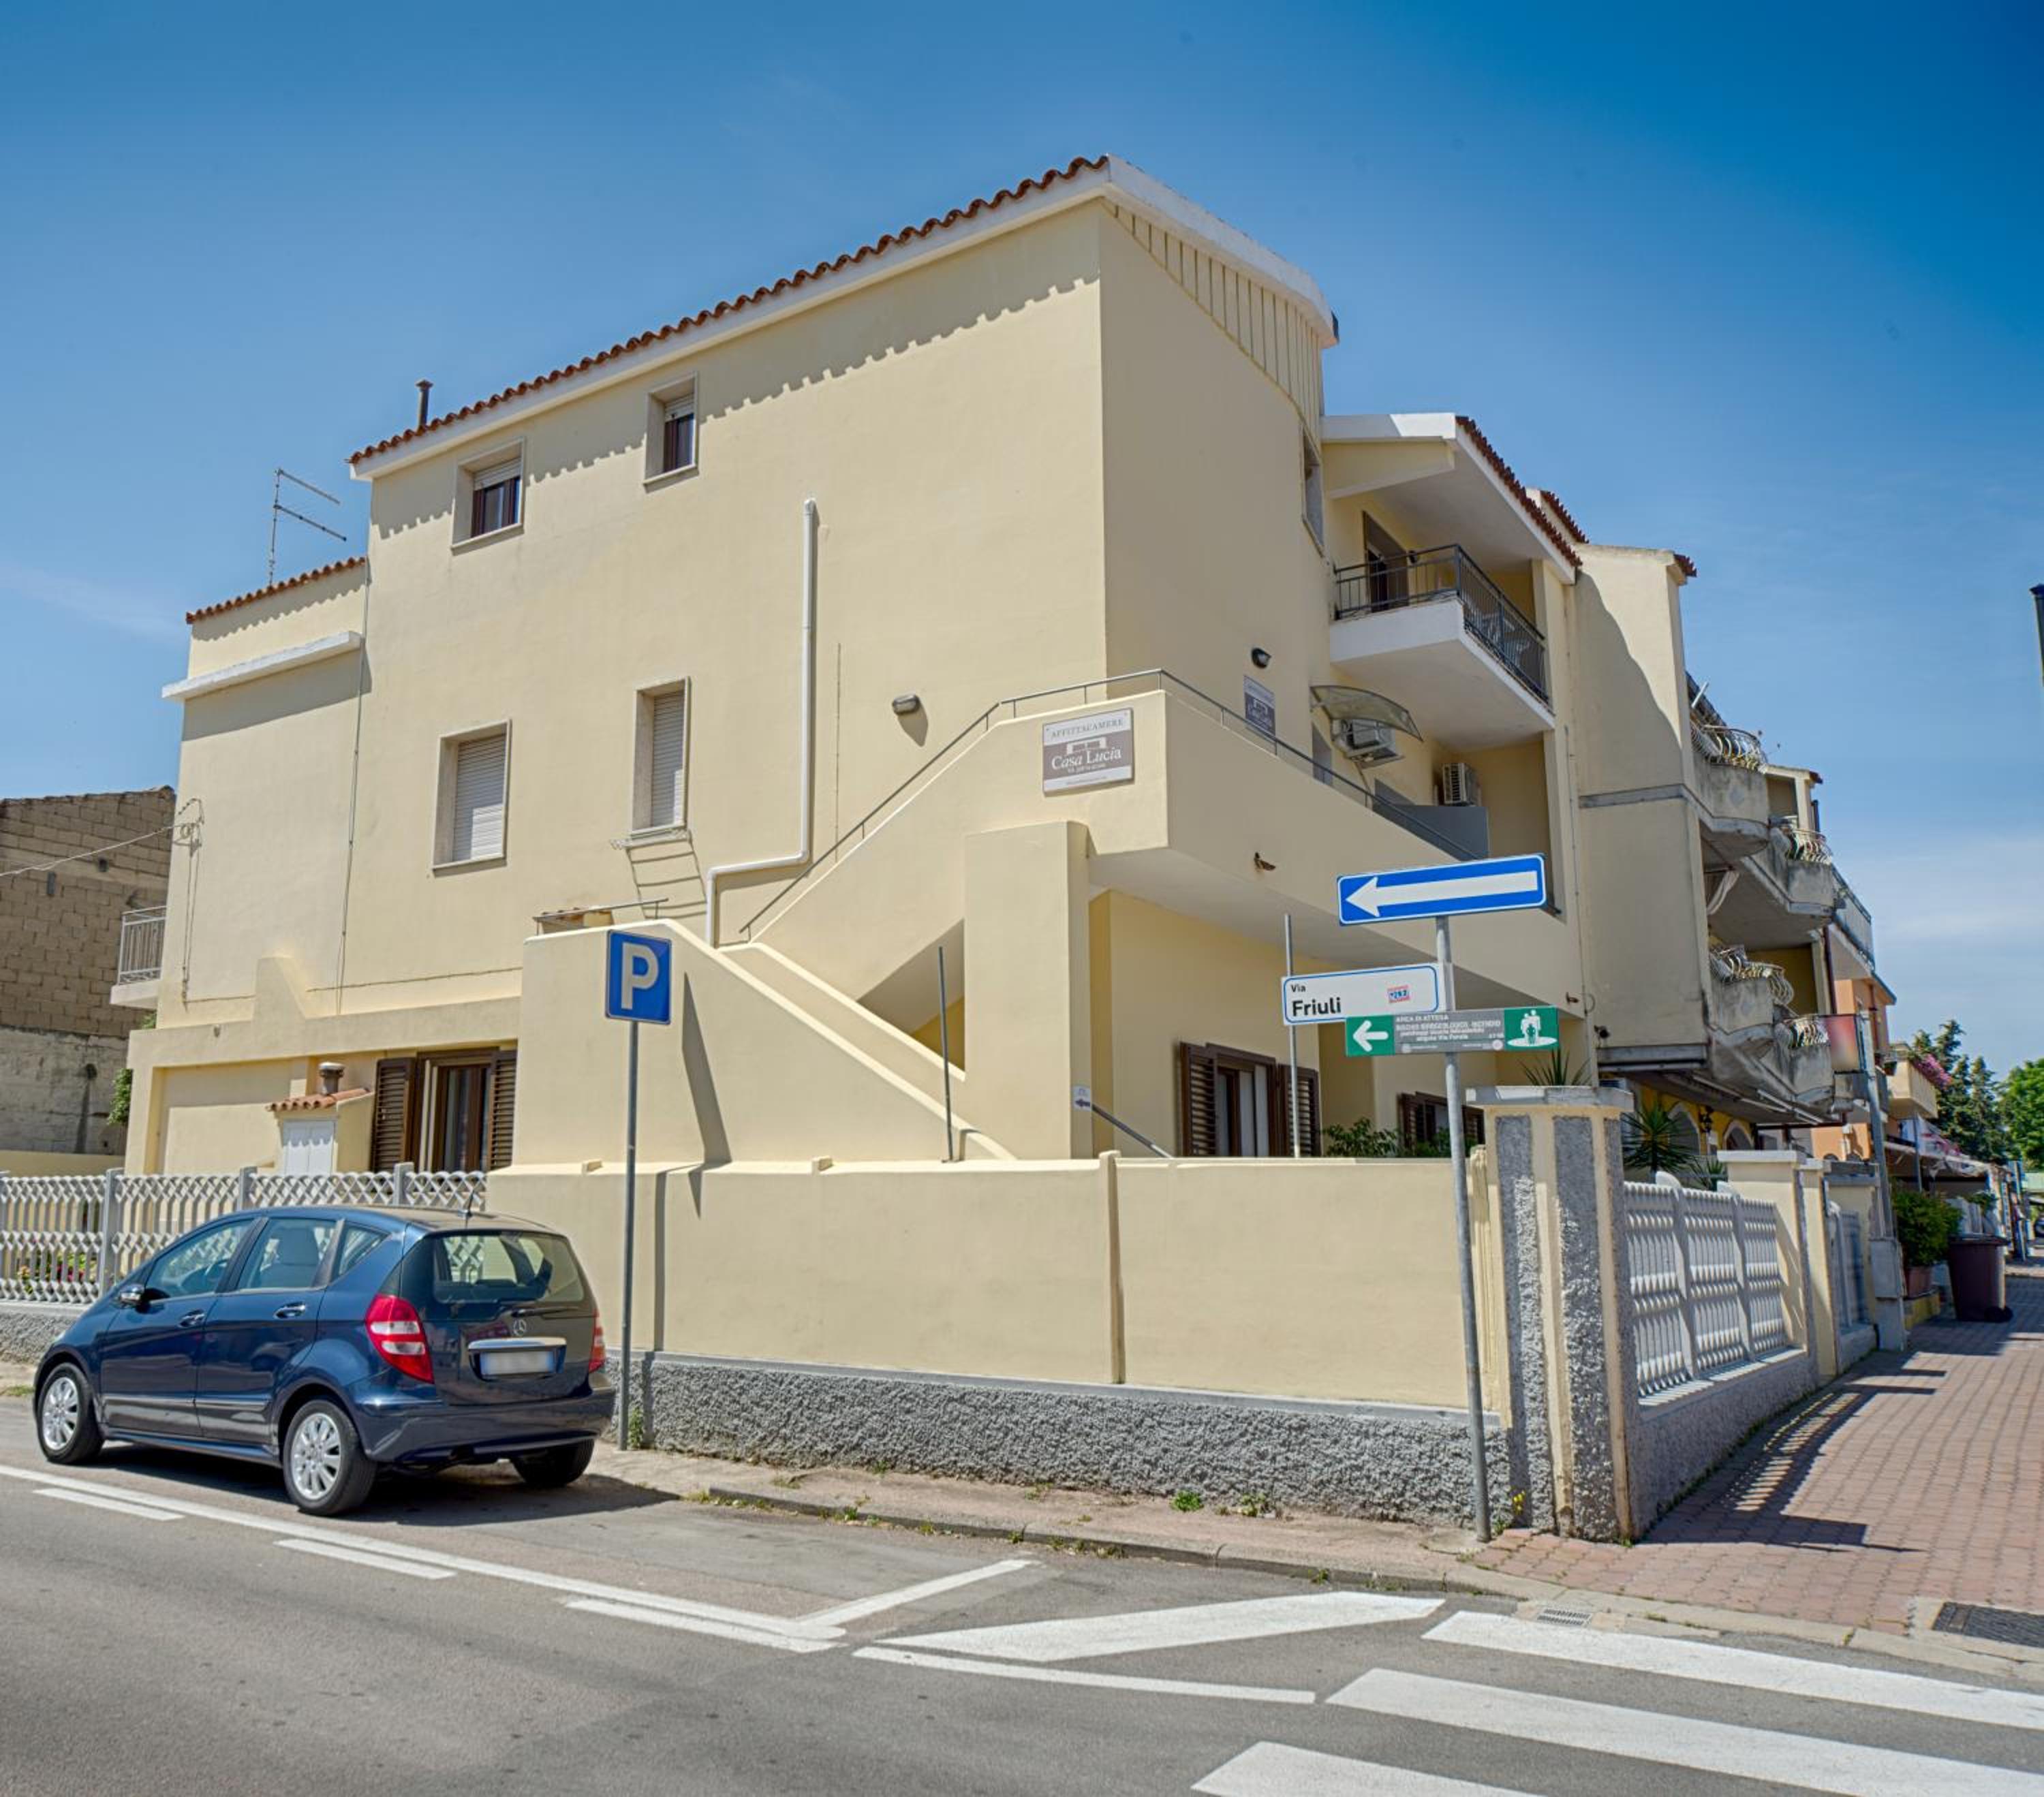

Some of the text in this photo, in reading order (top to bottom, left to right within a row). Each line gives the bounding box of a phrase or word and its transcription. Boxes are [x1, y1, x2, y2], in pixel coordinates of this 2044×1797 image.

[1051, 754, 1083, 770] Casa
[1086, 747, 1122, 764] Lucia
[621, 941, 659, 1010] P
[1291, 984, 1306, 993] Via
[1292, 997, 1342, 1017] Friuli
